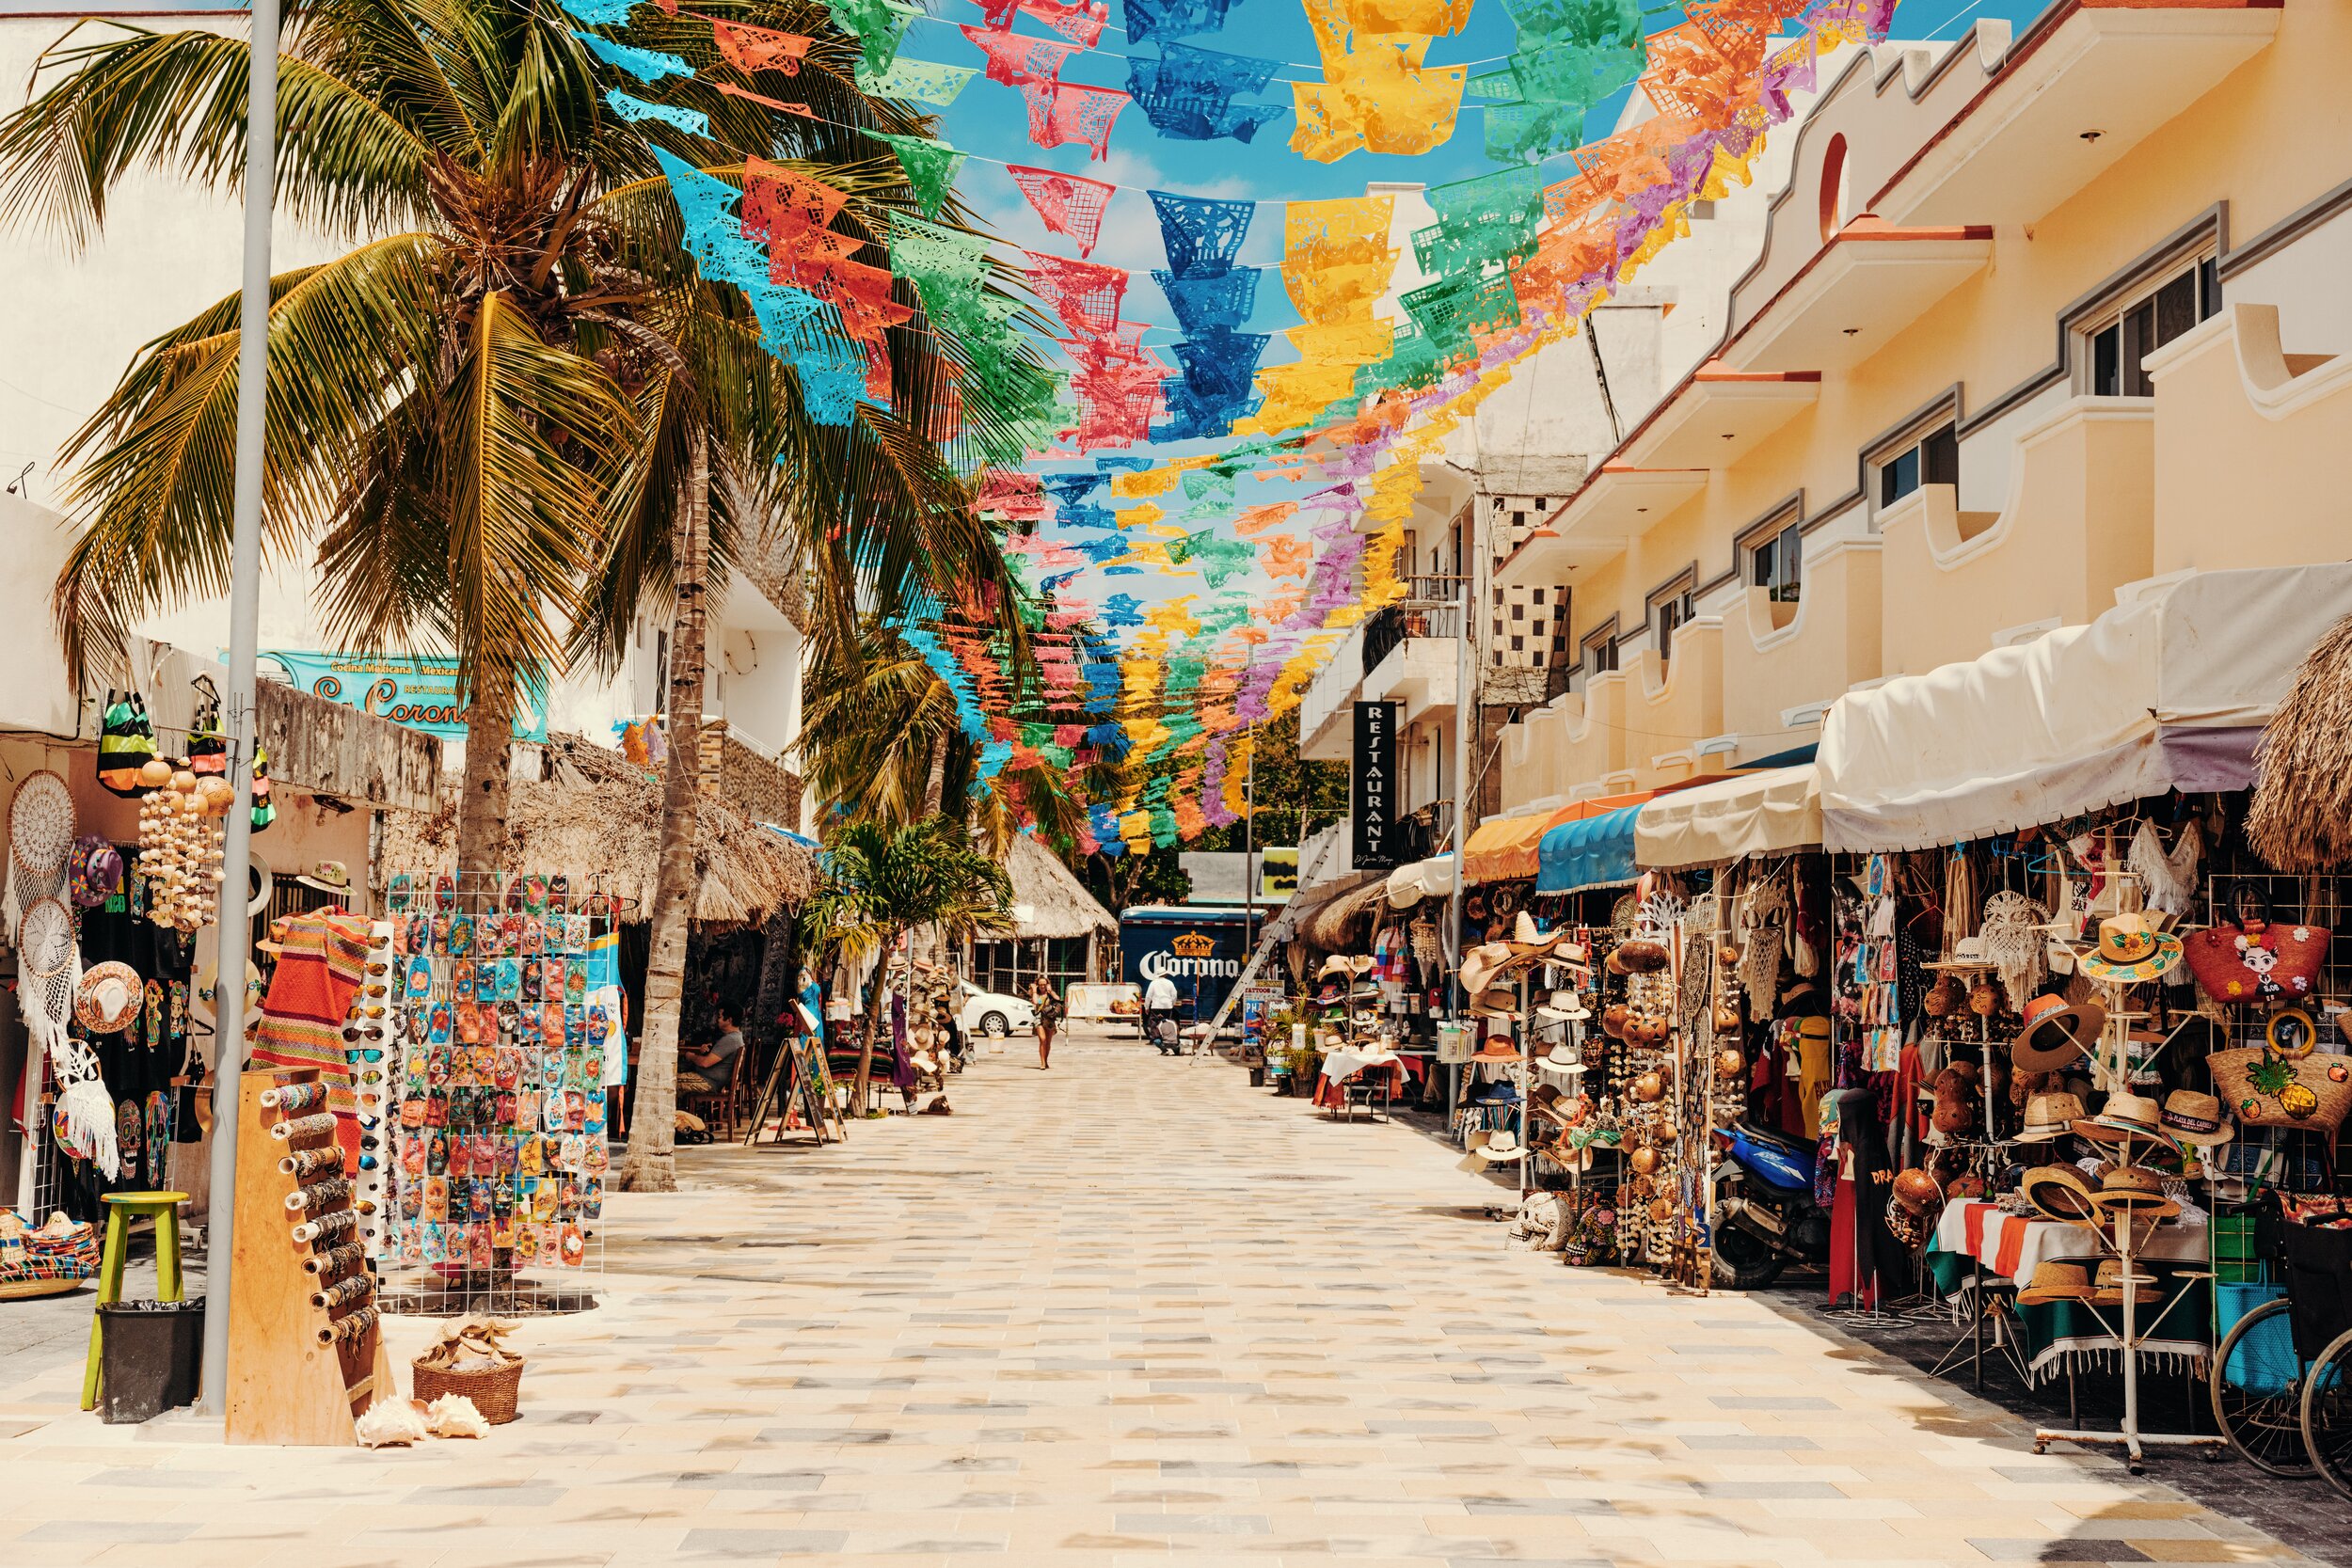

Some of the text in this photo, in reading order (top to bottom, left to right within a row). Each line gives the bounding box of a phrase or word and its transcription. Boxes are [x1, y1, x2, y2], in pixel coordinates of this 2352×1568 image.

[330, 661, 364, 673] Cocina
[364, 662, 413, 674] Mexicana
[404, 685, 469, 695] RESTAURA
[1365, 707, 1383, 852] RESTAURANT
[1138, 949, 1239, 981] Corona
[2173, 1115, 2186, 1125] PLAYA
[2186, 1117, 2196, 1127] DEL
[1870, 1168, 1894, 1185] DRA
